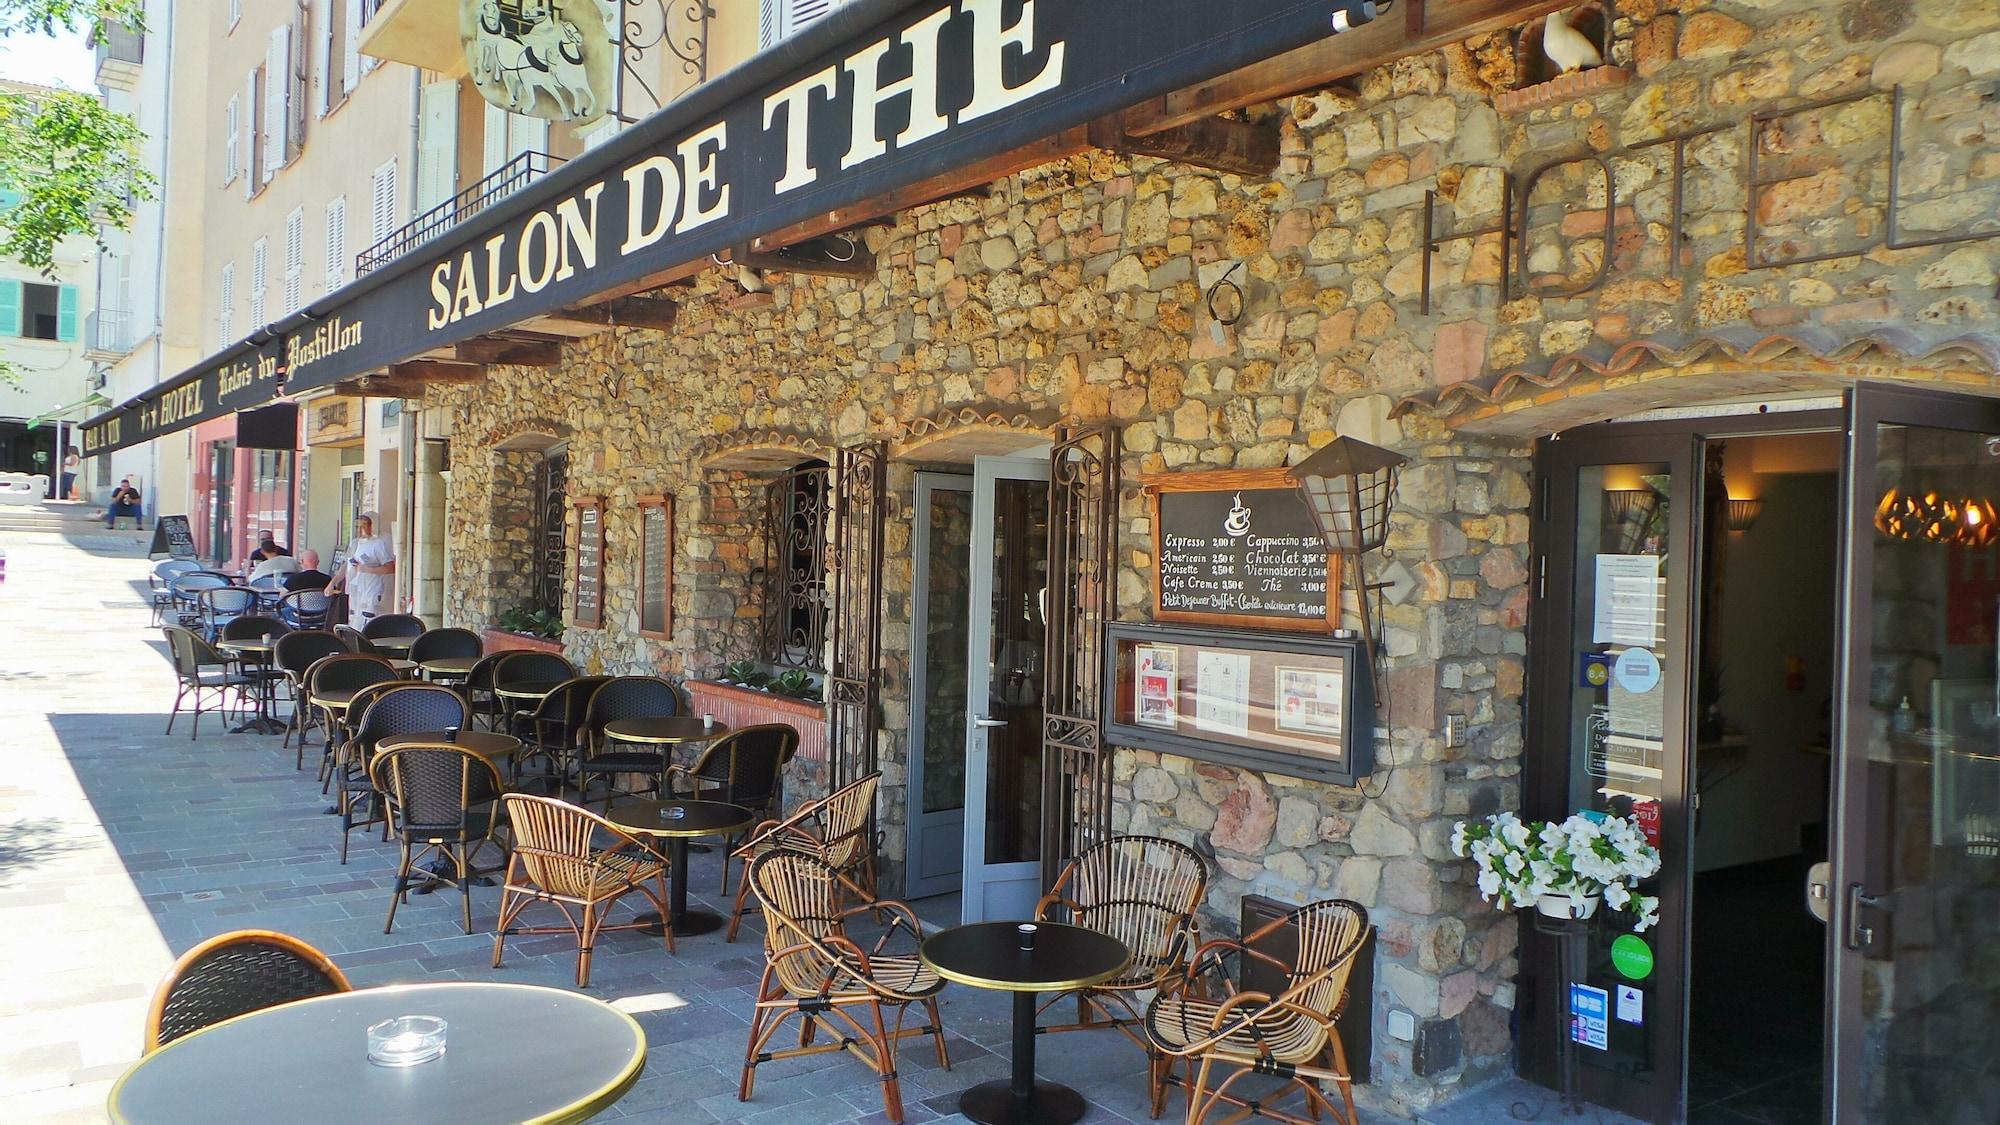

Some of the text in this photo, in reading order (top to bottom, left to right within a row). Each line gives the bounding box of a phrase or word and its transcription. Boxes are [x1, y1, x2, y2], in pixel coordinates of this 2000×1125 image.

[428, 0, 1065, 331] SALON DE THE
[160, 316, 363, 426] HOTEL Relais du Postillon
[1165, 534, 1205, 552] Expresso
[1247, 533, 1299, 552] Cappuccino
[1246, 549, 1299, 564] Chocolat
[1161, 562, 1198, 574] Noisette
[1244, 563, 1307, 577] Viennoiserie
[1163, 575, 1185, 592] Cafe
[1188, 576, 1219, 590] Creme
[1260, 577, 1282, 592] Thé
